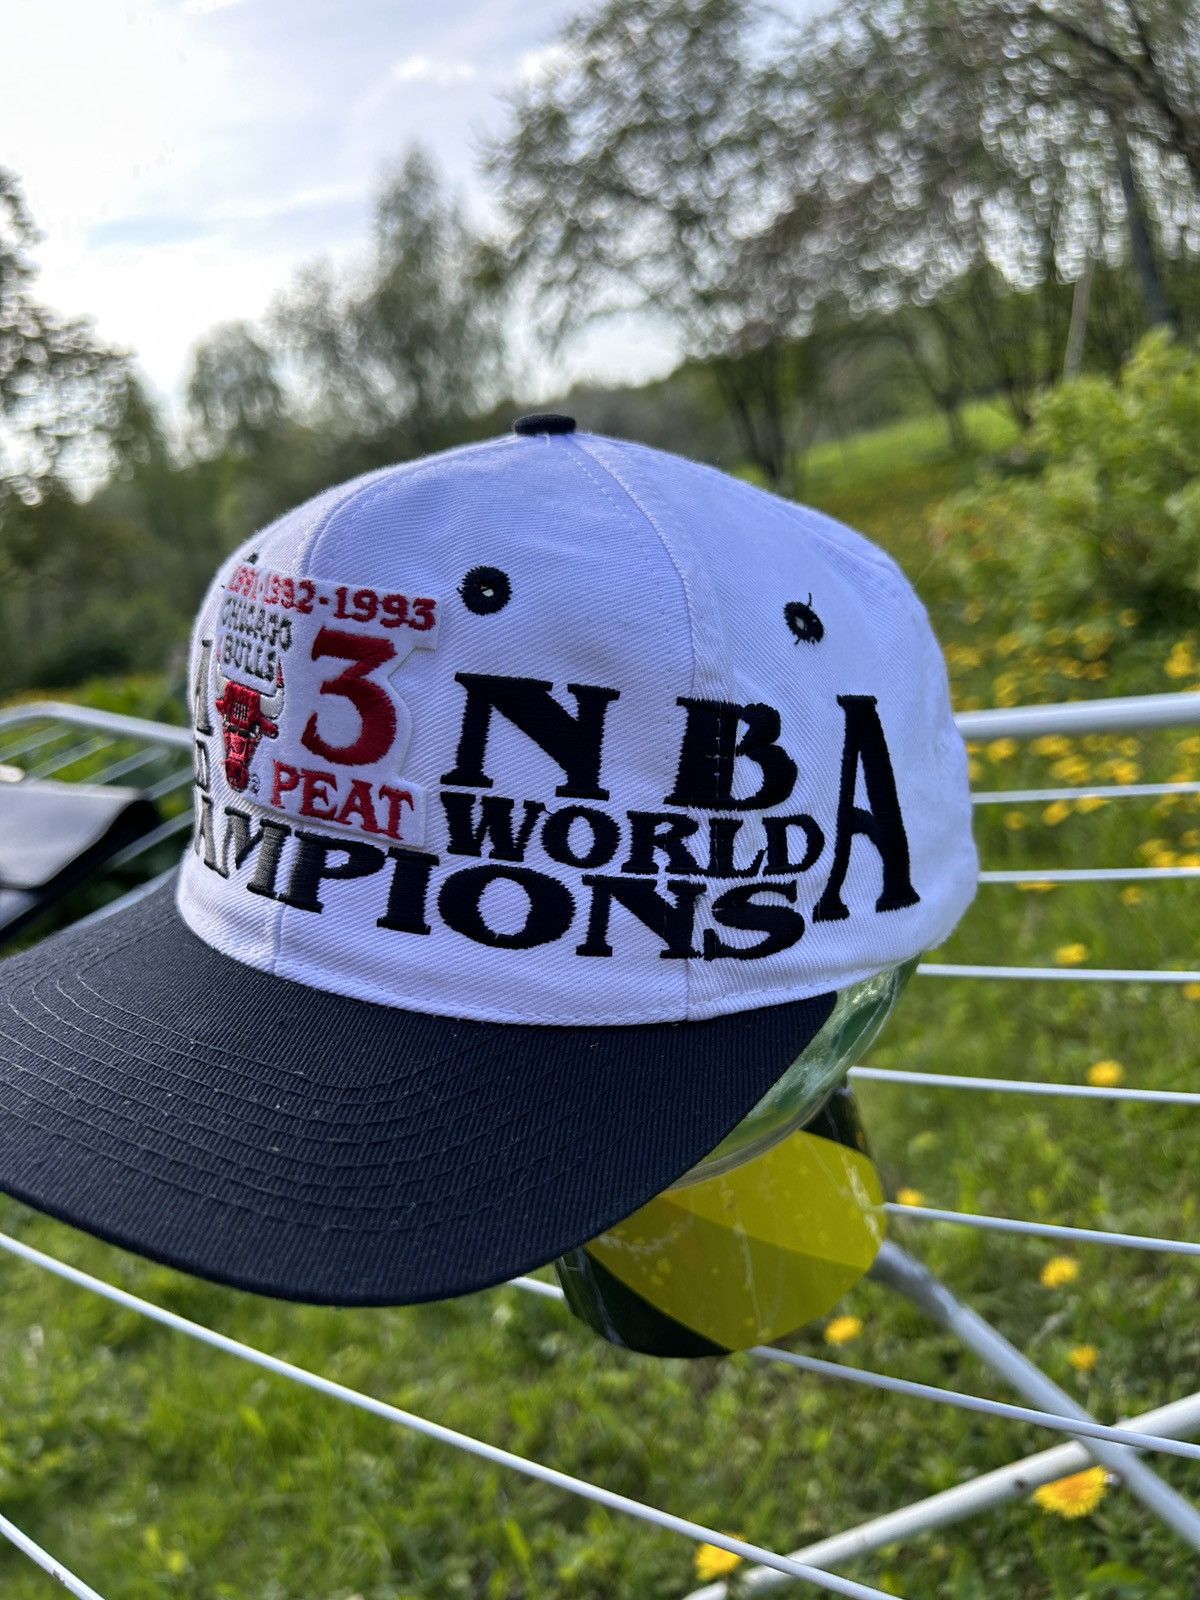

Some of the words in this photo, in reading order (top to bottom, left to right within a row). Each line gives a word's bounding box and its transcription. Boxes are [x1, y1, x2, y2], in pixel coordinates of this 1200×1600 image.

[223, 633, 276, 682] BULLS
[300, 625, 398, 767] 3
[270, 758, 415, 841] PEAT
[440, 791, 826, 879] WORLD
[195, 794, 806, 961] AMPIONS
